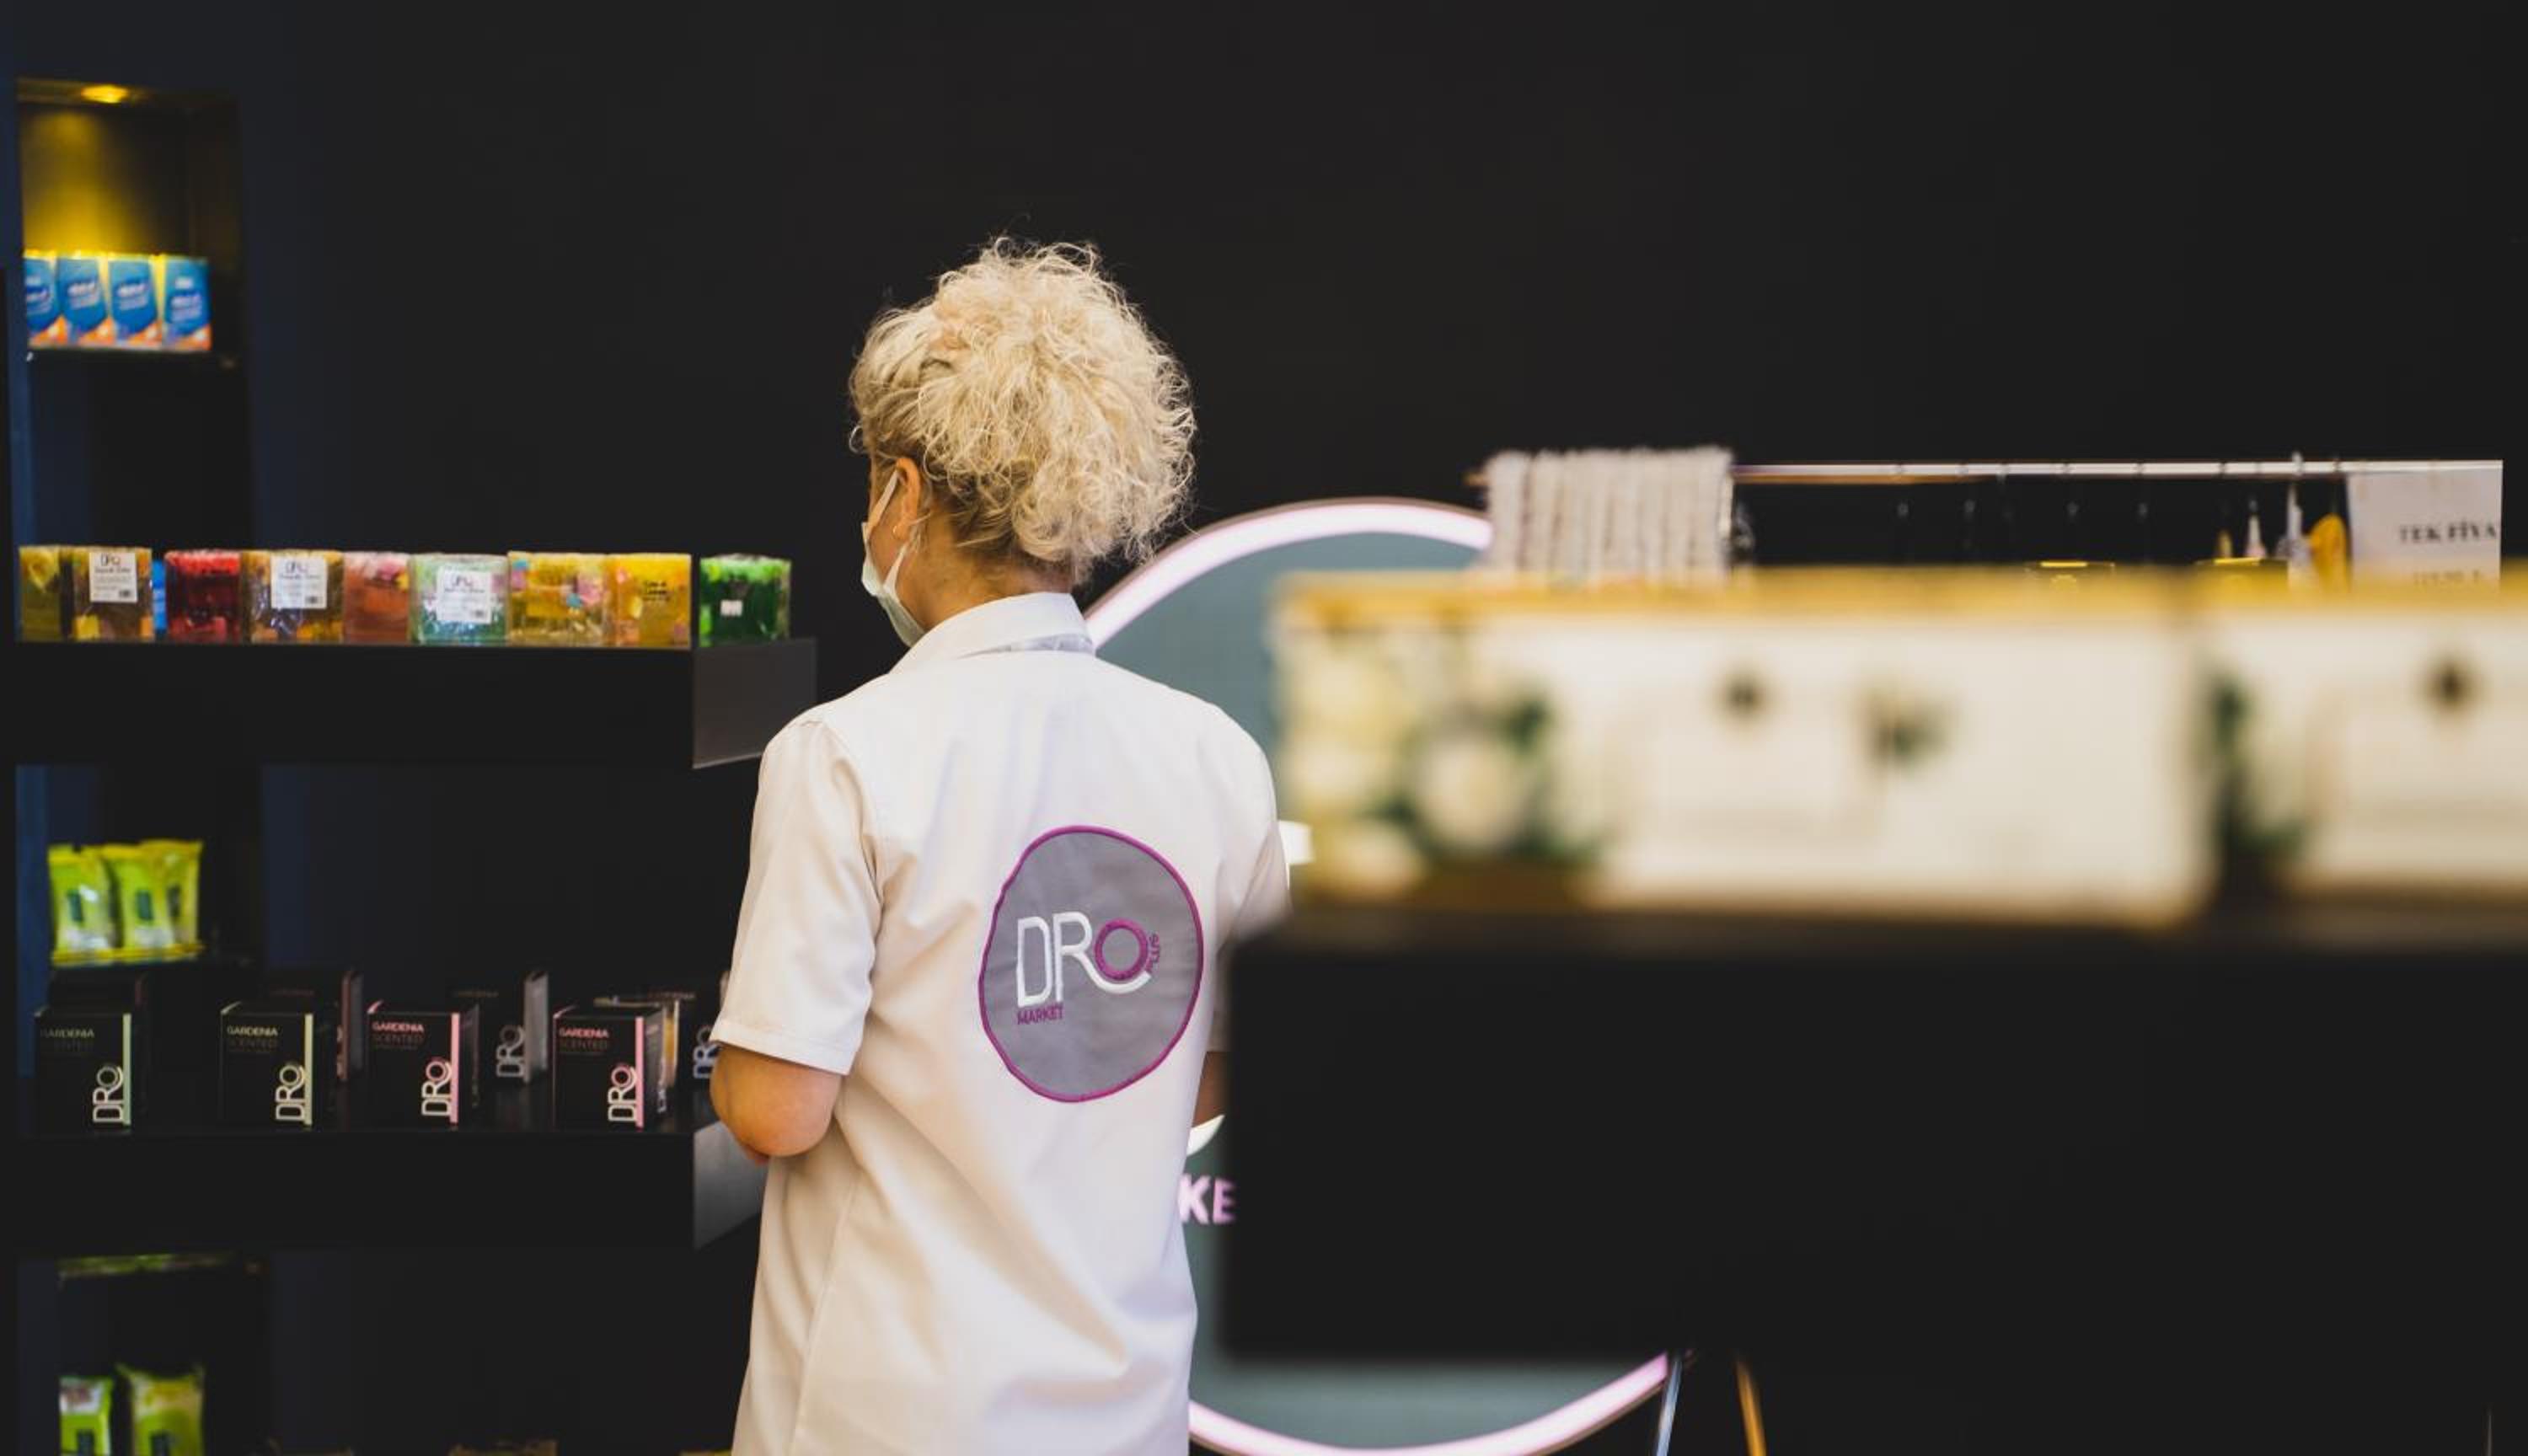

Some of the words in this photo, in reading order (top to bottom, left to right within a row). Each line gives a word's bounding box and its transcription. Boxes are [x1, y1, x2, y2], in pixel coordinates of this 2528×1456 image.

[1016, 911, 1152, 1009] DRO
[226, 1025, 280, 1038] GARDENIA
[371, 1021, 426, 1033] GARDENIA
[558, 1026, 610, 1039] GARDENIA
[1016, 1003, 1063, 1025] MARKET
[495, 1024, 524, 1079] DRO
[92, 1063, 124, 1123] DRO
[275, 1063, 305, 1121] DRO
[420, 1057, 453, 1117] DRO
[608, 1063, 637, 1123] DRO
